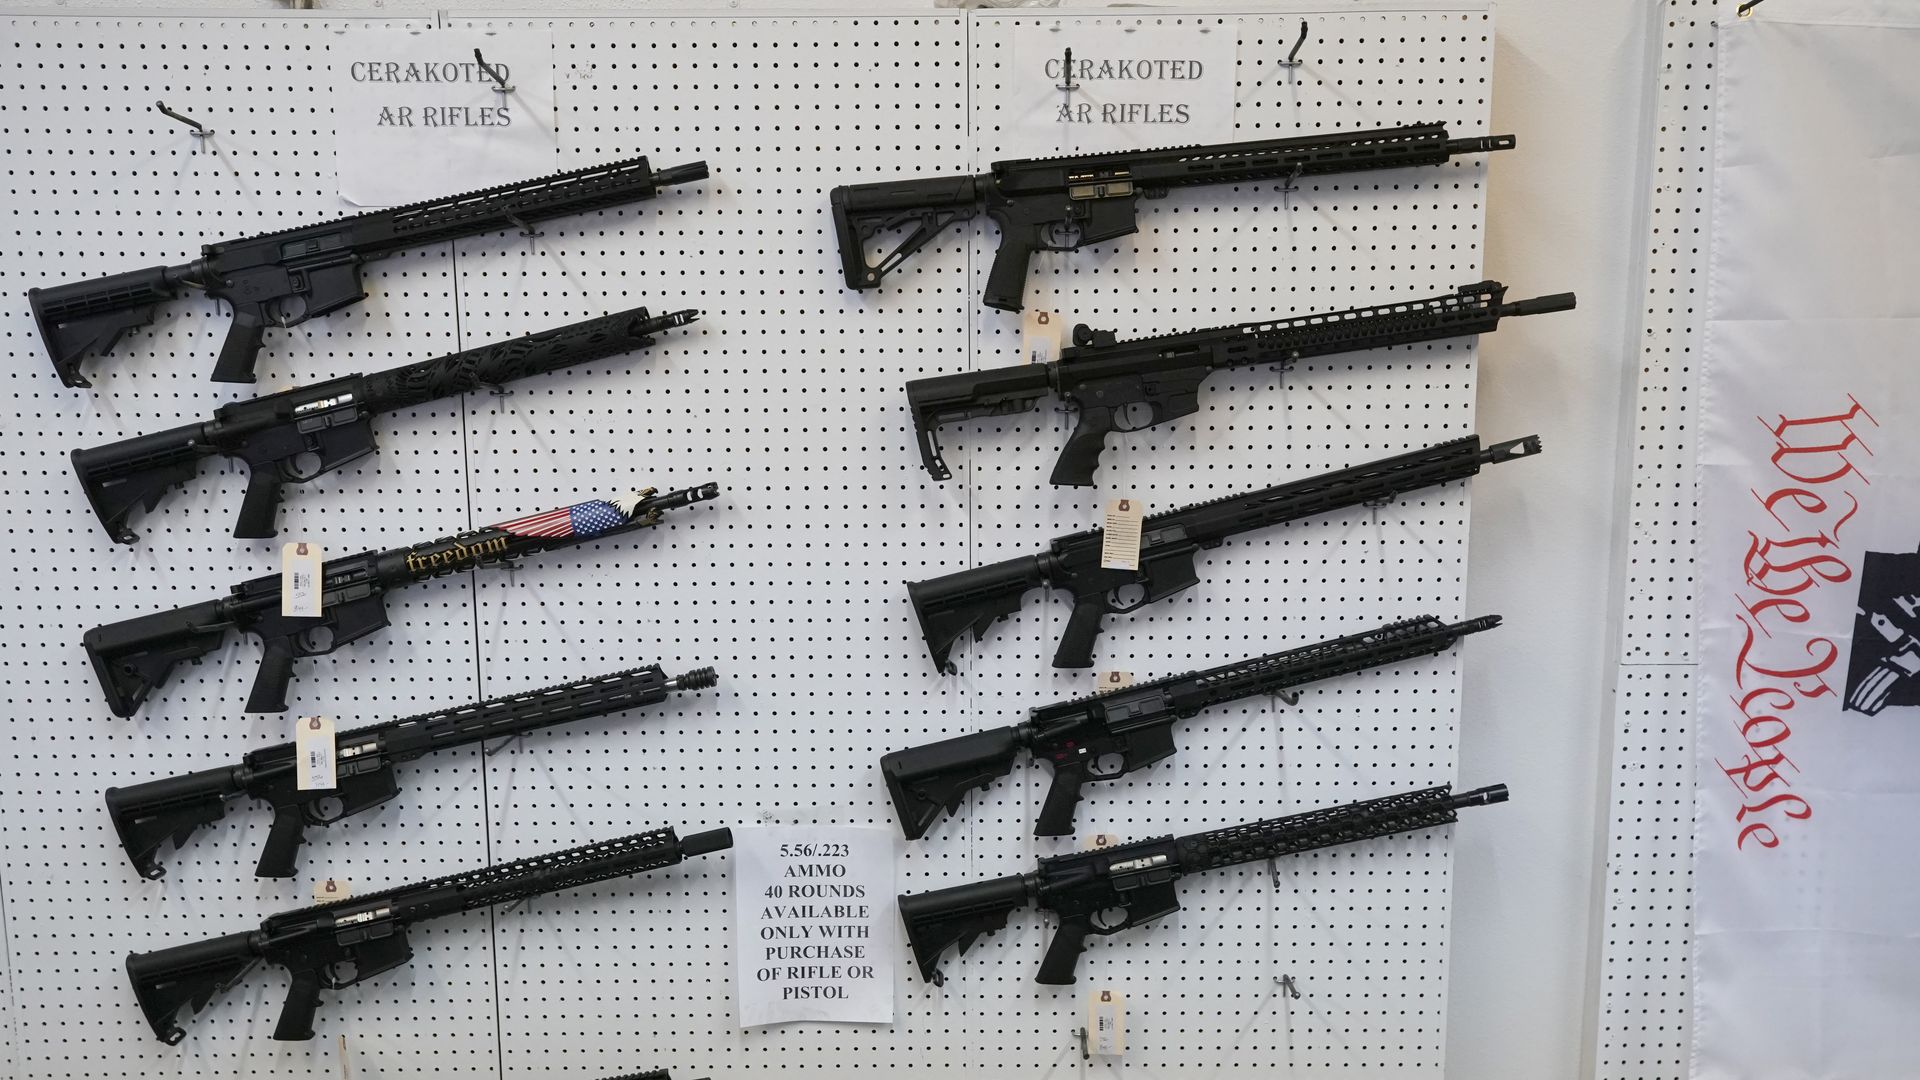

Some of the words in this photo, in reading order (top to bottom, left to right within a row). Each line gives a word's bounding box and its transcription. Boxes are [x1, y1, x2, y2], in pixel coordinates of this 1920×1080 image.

[350, 61, 510, 83] CERAKOTED
[1044, 58, 1204, 81] CERAKOTED
[377, 106, 414, 128] AR
[422, 106, 512, 127] RIFLES
[1056, 103, 1092, 125] AR
[1102, 103, 1190, 125] RIFLES
[406, 536, 507, 572] freedom
[1715, 613, 1839, 851] People
[780, 843, 850, 858] 5.56/.223
[783, 864, 846, 878] AMMO
[764, 885, 783, 899] 40
[788, 884, 866, 899] ROUNDS
[760, 905, 870, 920] AVAILABLE
[760, 926, 813, 940] ONLY
[818, 925, 869, 939] WITH
[765, 945, 865, 960] PURCHASE
[756, 967, 782, 982] OF
[787, 965, 842, 979] RIFLE
[847, 965, 874, 979] OR
[782, 986, 849, 1000] PISTOL
